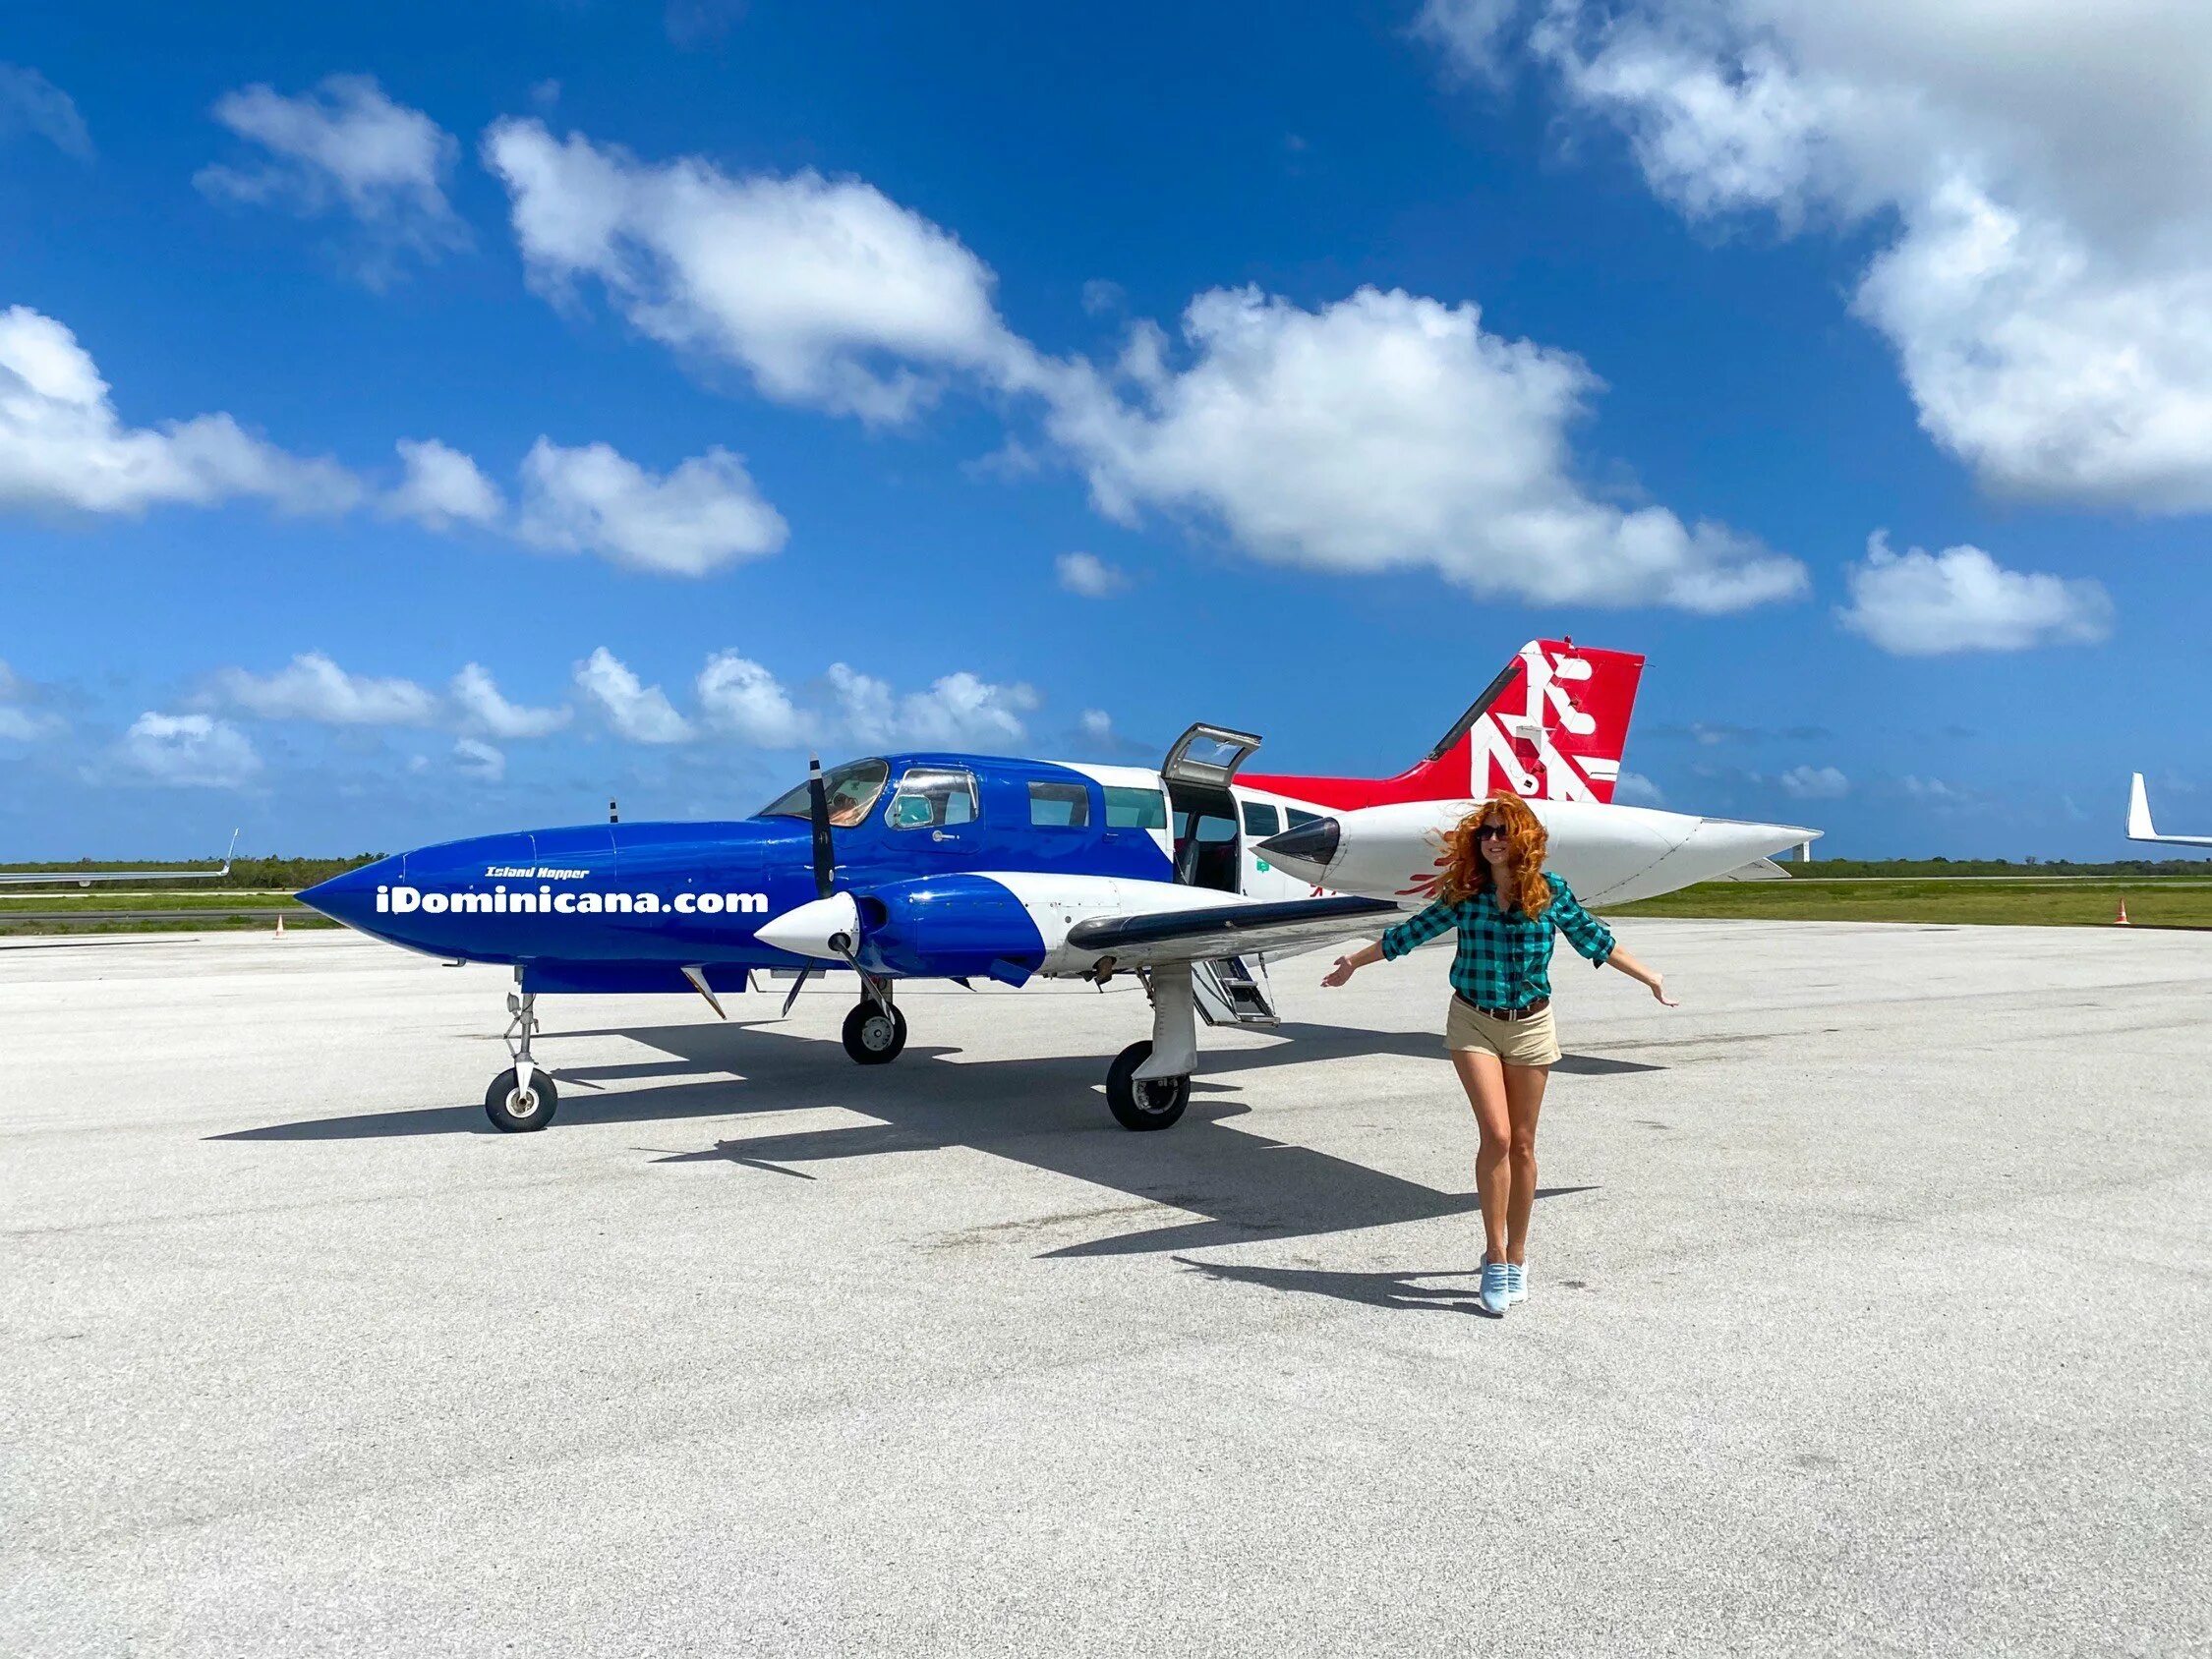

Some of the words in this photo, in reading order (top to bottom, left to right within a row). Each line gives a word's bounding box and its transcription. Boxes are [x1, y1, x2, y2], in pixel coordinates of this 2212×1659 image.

[485, 866, 536, 878] Island
[537, 867, 590, 881] Hopper
[376, 885, 769, 914] iDominicana.com
